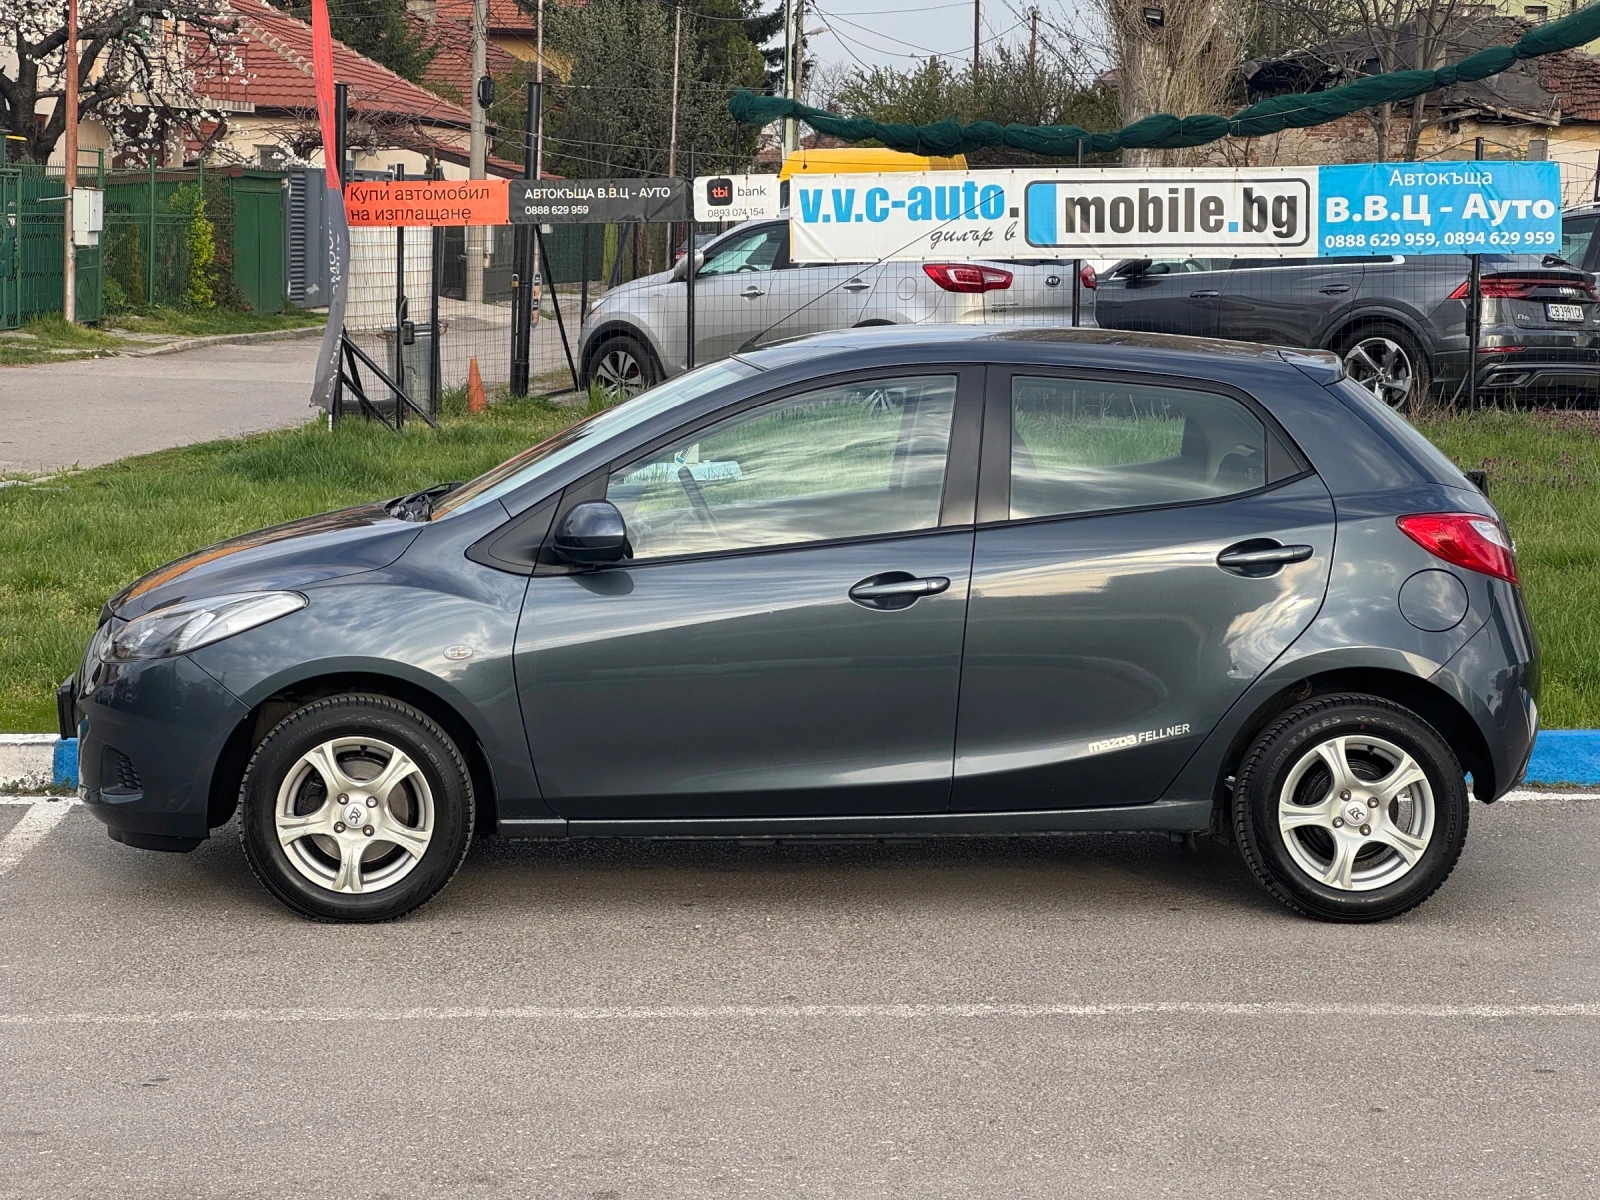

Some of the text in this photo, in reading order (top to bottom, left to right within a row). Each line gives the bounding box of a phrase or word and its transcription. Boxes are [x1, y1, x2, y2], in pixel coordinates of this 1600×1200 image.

[1389, 169, 1493, 188] Автокъща
[350, 186, 490, 204] Купи автомобил
[525, 187, 595, 200] АВТОКЪЩА
[597, 187, 630, 200] В.В.Ц
[639, 187, 671, 198] АУТО
[711, 186, 728, 198] tbi
[737, 185, 767, 197] bank
[351, 208, 472, 222] на изплащане
[525, 205, 589, 215] 0888 629 959
[707, 207, 765, 218] 0893 074 154
[1065, 187, 1298, 238] mobile.bg
[1326, 194, 1431, 226] В.В.Ц
[1462, 193, 1555, 226] Ауто
[930, 226, 995, 250] дилър
[1325, 231, 1555, 248] 0888 629 959, 0894 629 959
[1138, 723, 1191, 743] FELLNER
[1288, 715, 1341, 745] TYRES
